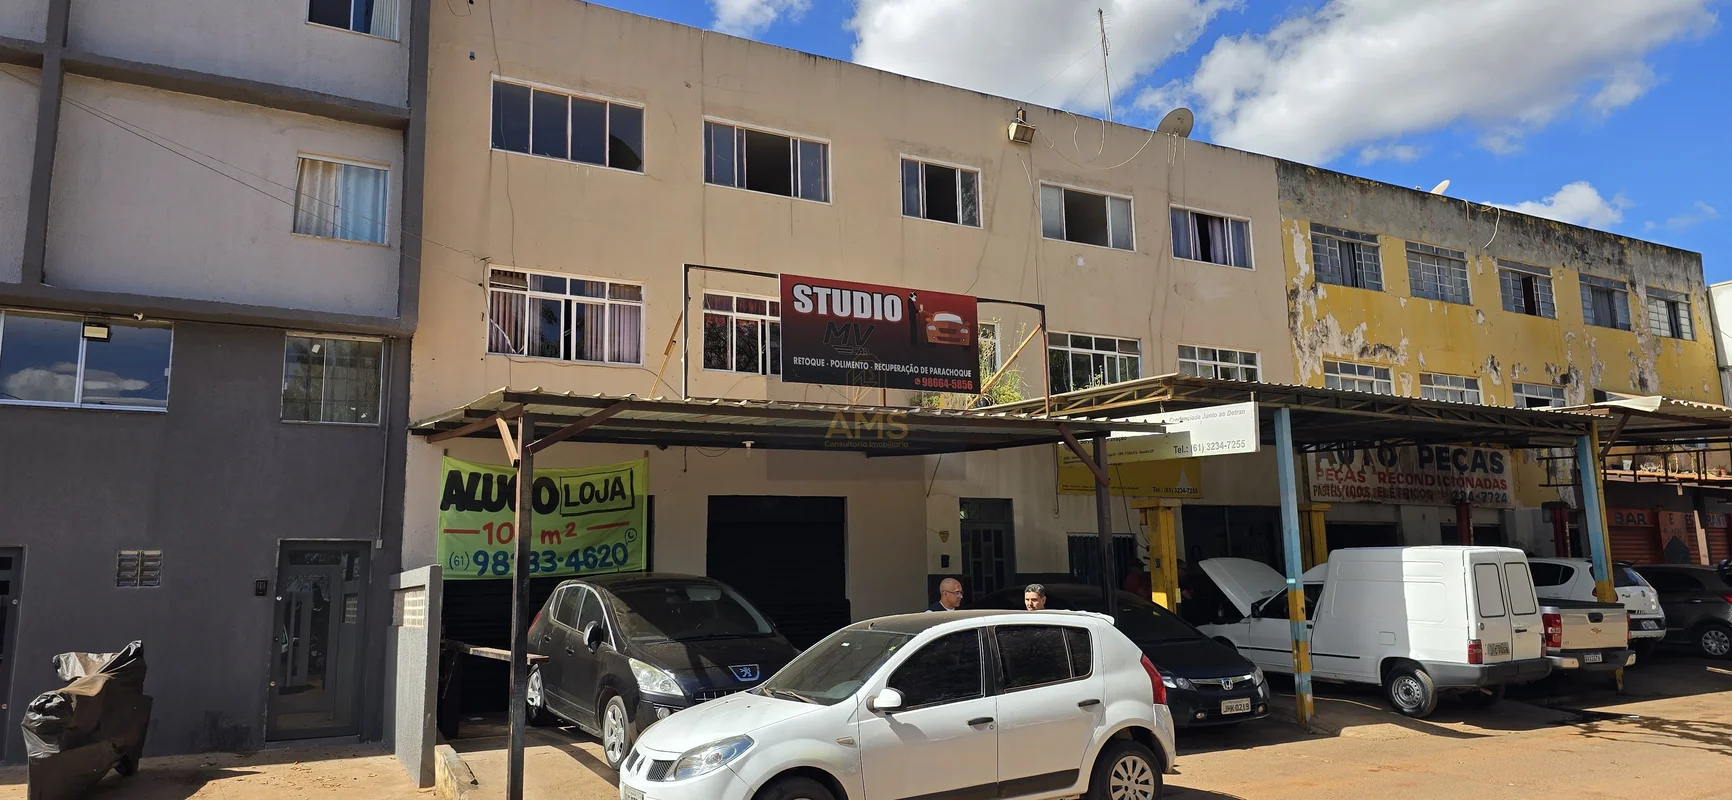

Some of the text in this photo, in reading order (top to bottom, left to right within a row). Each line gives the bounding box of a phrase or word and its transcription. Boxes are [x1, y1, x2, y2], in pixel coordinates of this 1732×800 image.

[792, 283, 903, 322] STUDIO
[823, 321, 876, 347] MV
[793, 357, 825, 367] RETOQUE
[830, 359, 869, 370] POLIMENTO
[874, 363, 919, 375] RECUPERAÇÃO
[920, 366, 929, 375] DE
[929, 367, 972, 378] PARACHOQUE
[922, 377, 973, 390] 98664-5856
[1202, 412, 1217, 420] Junto
[1227, 409, 1246, 417] Detran
[1173, 439, 1246, 454] Tel.: (61) 3234-7255
[1316, 468, 1508, 490] PEÇAS RECONDICIONADAS
[564, 476, 627, 508] LOJA
[1614, 512, 1647, 525] BAR
[449, 551, 469, 571] (61)
